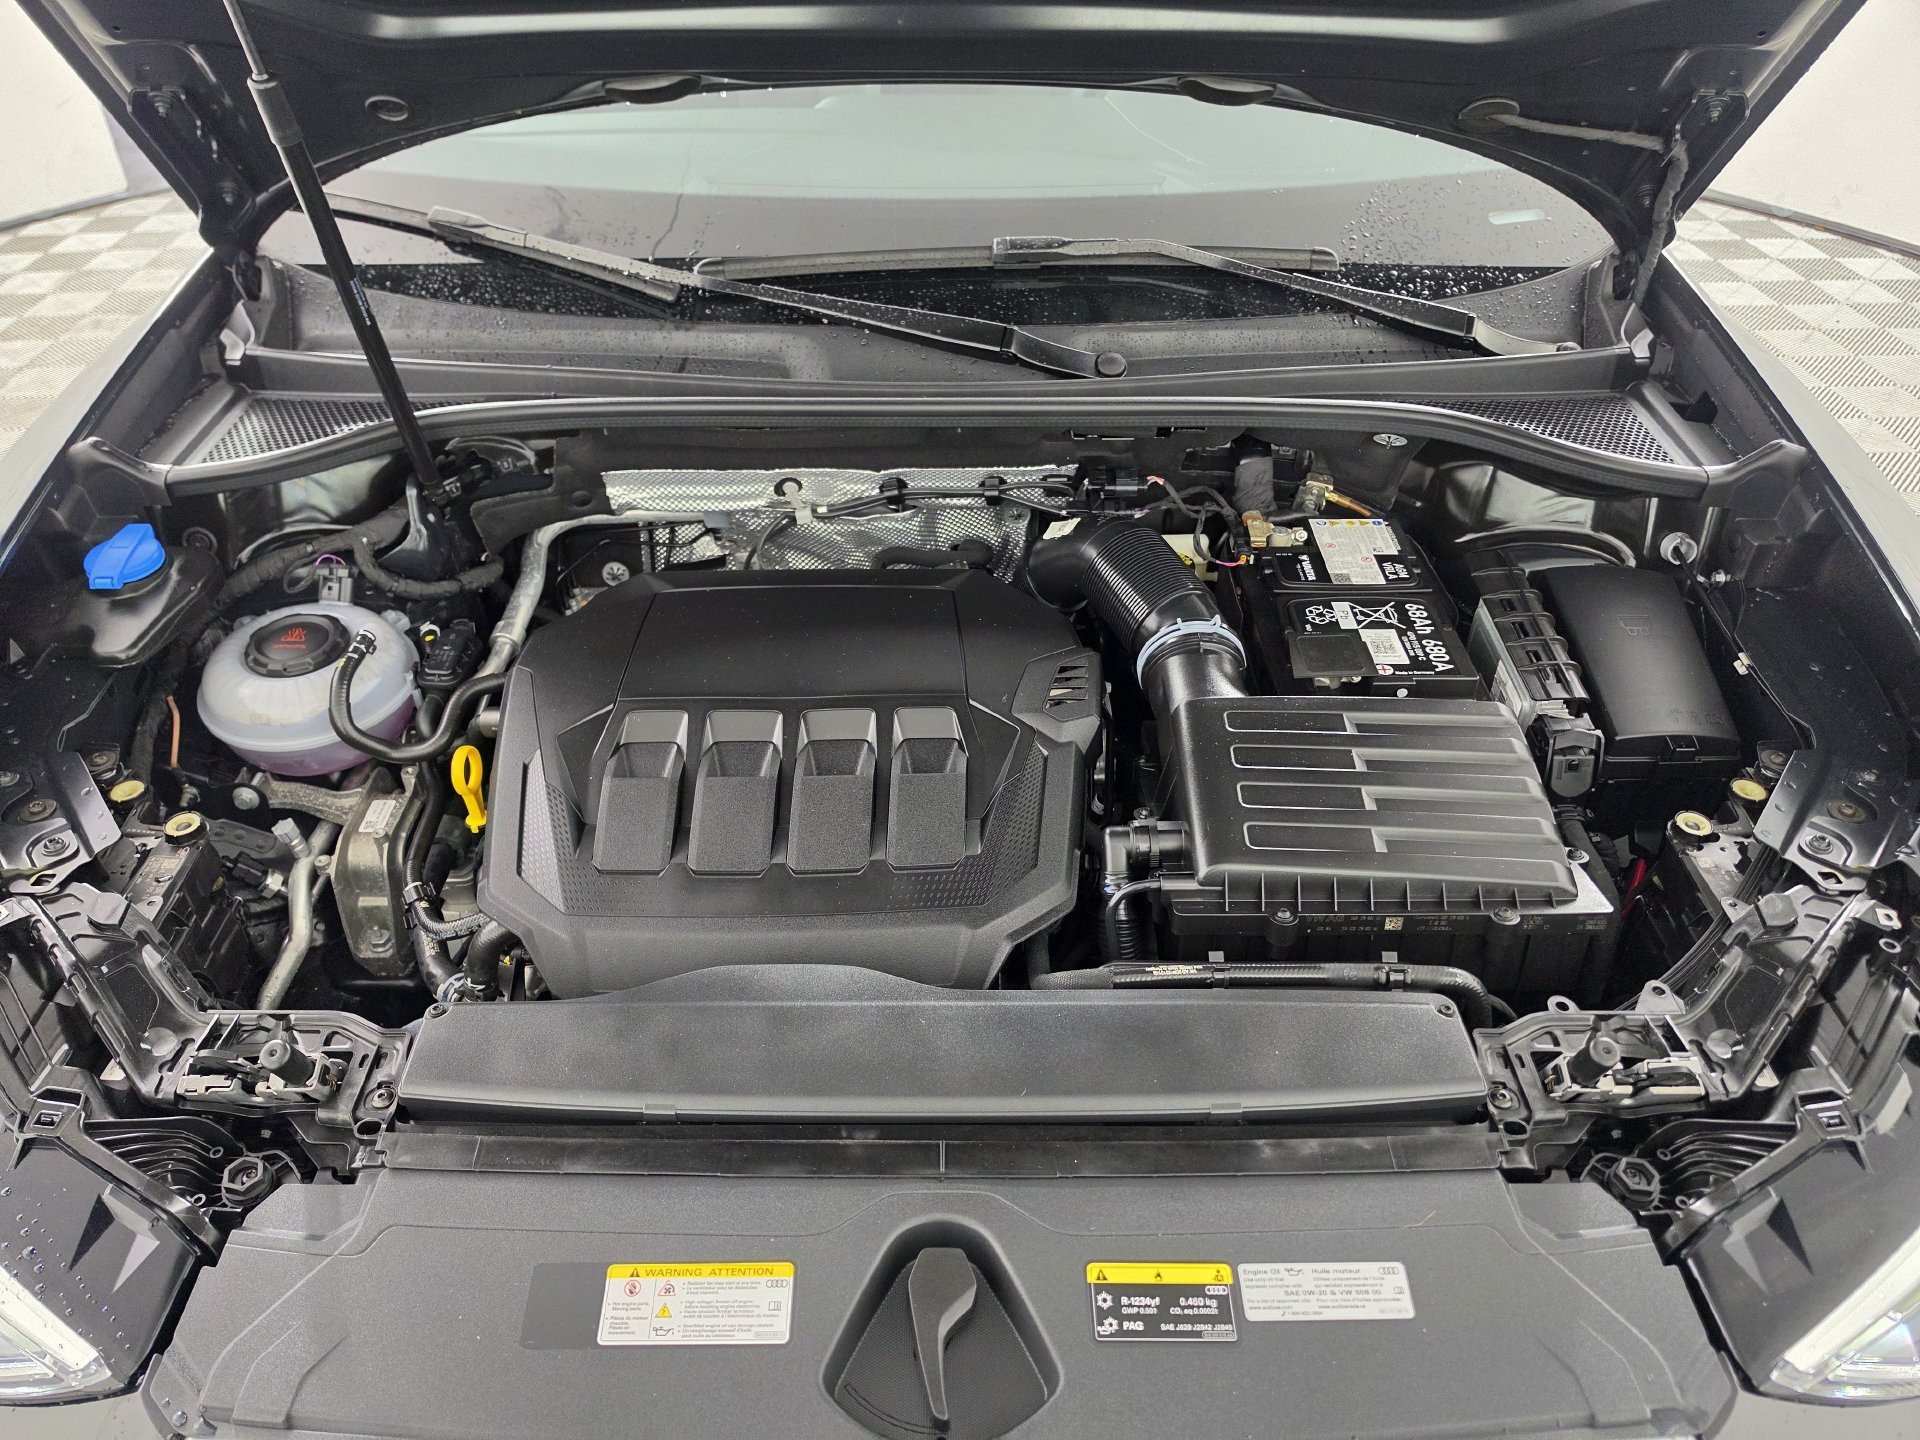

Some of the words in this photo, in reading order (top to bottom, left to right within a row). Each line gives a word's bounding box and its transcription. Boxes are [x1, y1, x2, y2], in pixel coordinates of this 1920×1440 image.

[1301, 560, 1317, 581] VARTA
[1381, 562, 1398, 580] VRLA
[1392, 563, 1410, 578] AGM
[1338, 610, 1349, 620] Pb
[1404, 603, 1435, 634] 68Ah
[1421, 639, 1455, 672] 680A
[645, 1268, 702, 1277] WARNING
[708, 1267, 775, 1276] ATTENTION
[1242, 1268, 1268, 1276] Engine
[1120, 1296, 1161, 1307] R-1234yf
[1205, 1297, 1218, 1308] kg
[1122, 1321, 1145, 1331] PAG
